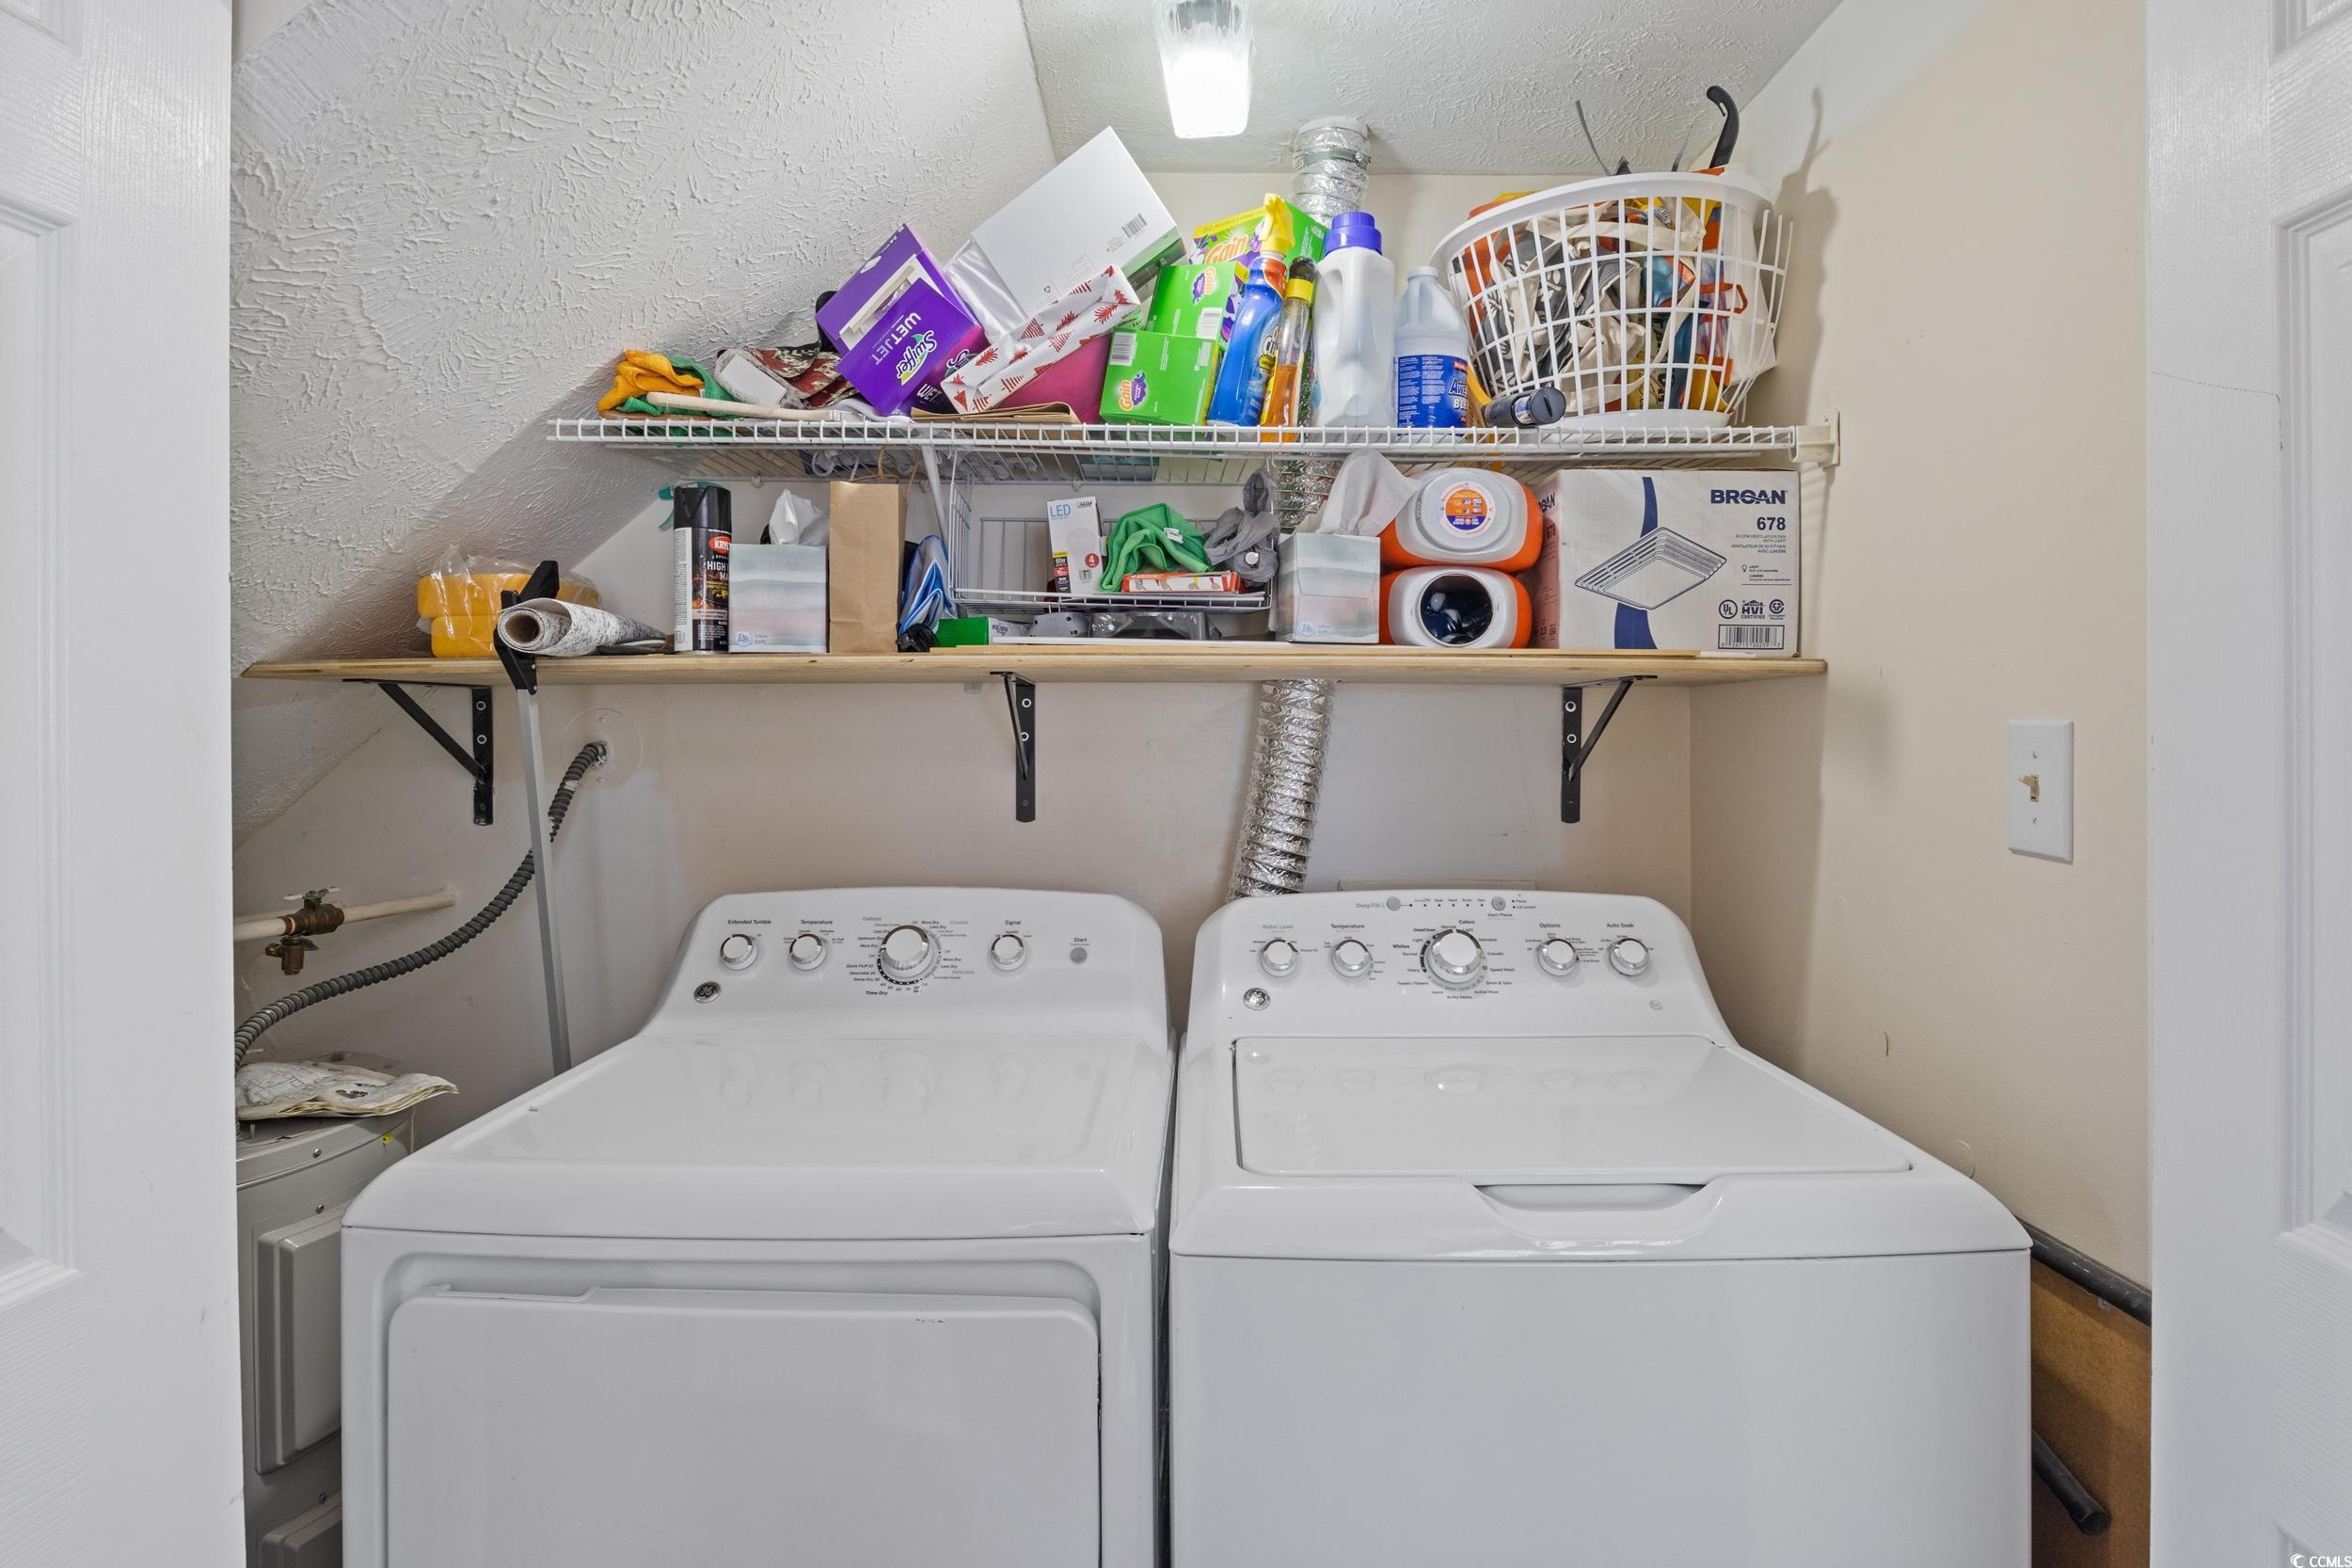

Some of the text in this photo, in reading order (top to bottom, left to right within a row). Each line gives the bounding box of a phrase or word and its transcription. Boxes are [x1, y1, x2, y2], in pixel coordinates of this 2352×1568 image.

[1205, 234, 1249, 263] Gain
[1204, 266, 1217, 294] Gain
[896, 330, 938, 379] Swiffer
[1119, 379, 1134, 411] Gain
[1710, 489, 1786, 504] BROAN
[1050, 504, 1071, 517] LED
[1756, 516, 1786, 531] 678
[714, 539, 730, 551] KRYL
[707, 561, 726, 571] HIGH
[1089, 555, 1095, 563] 4
[1723, 604, 1733, 615] UL
